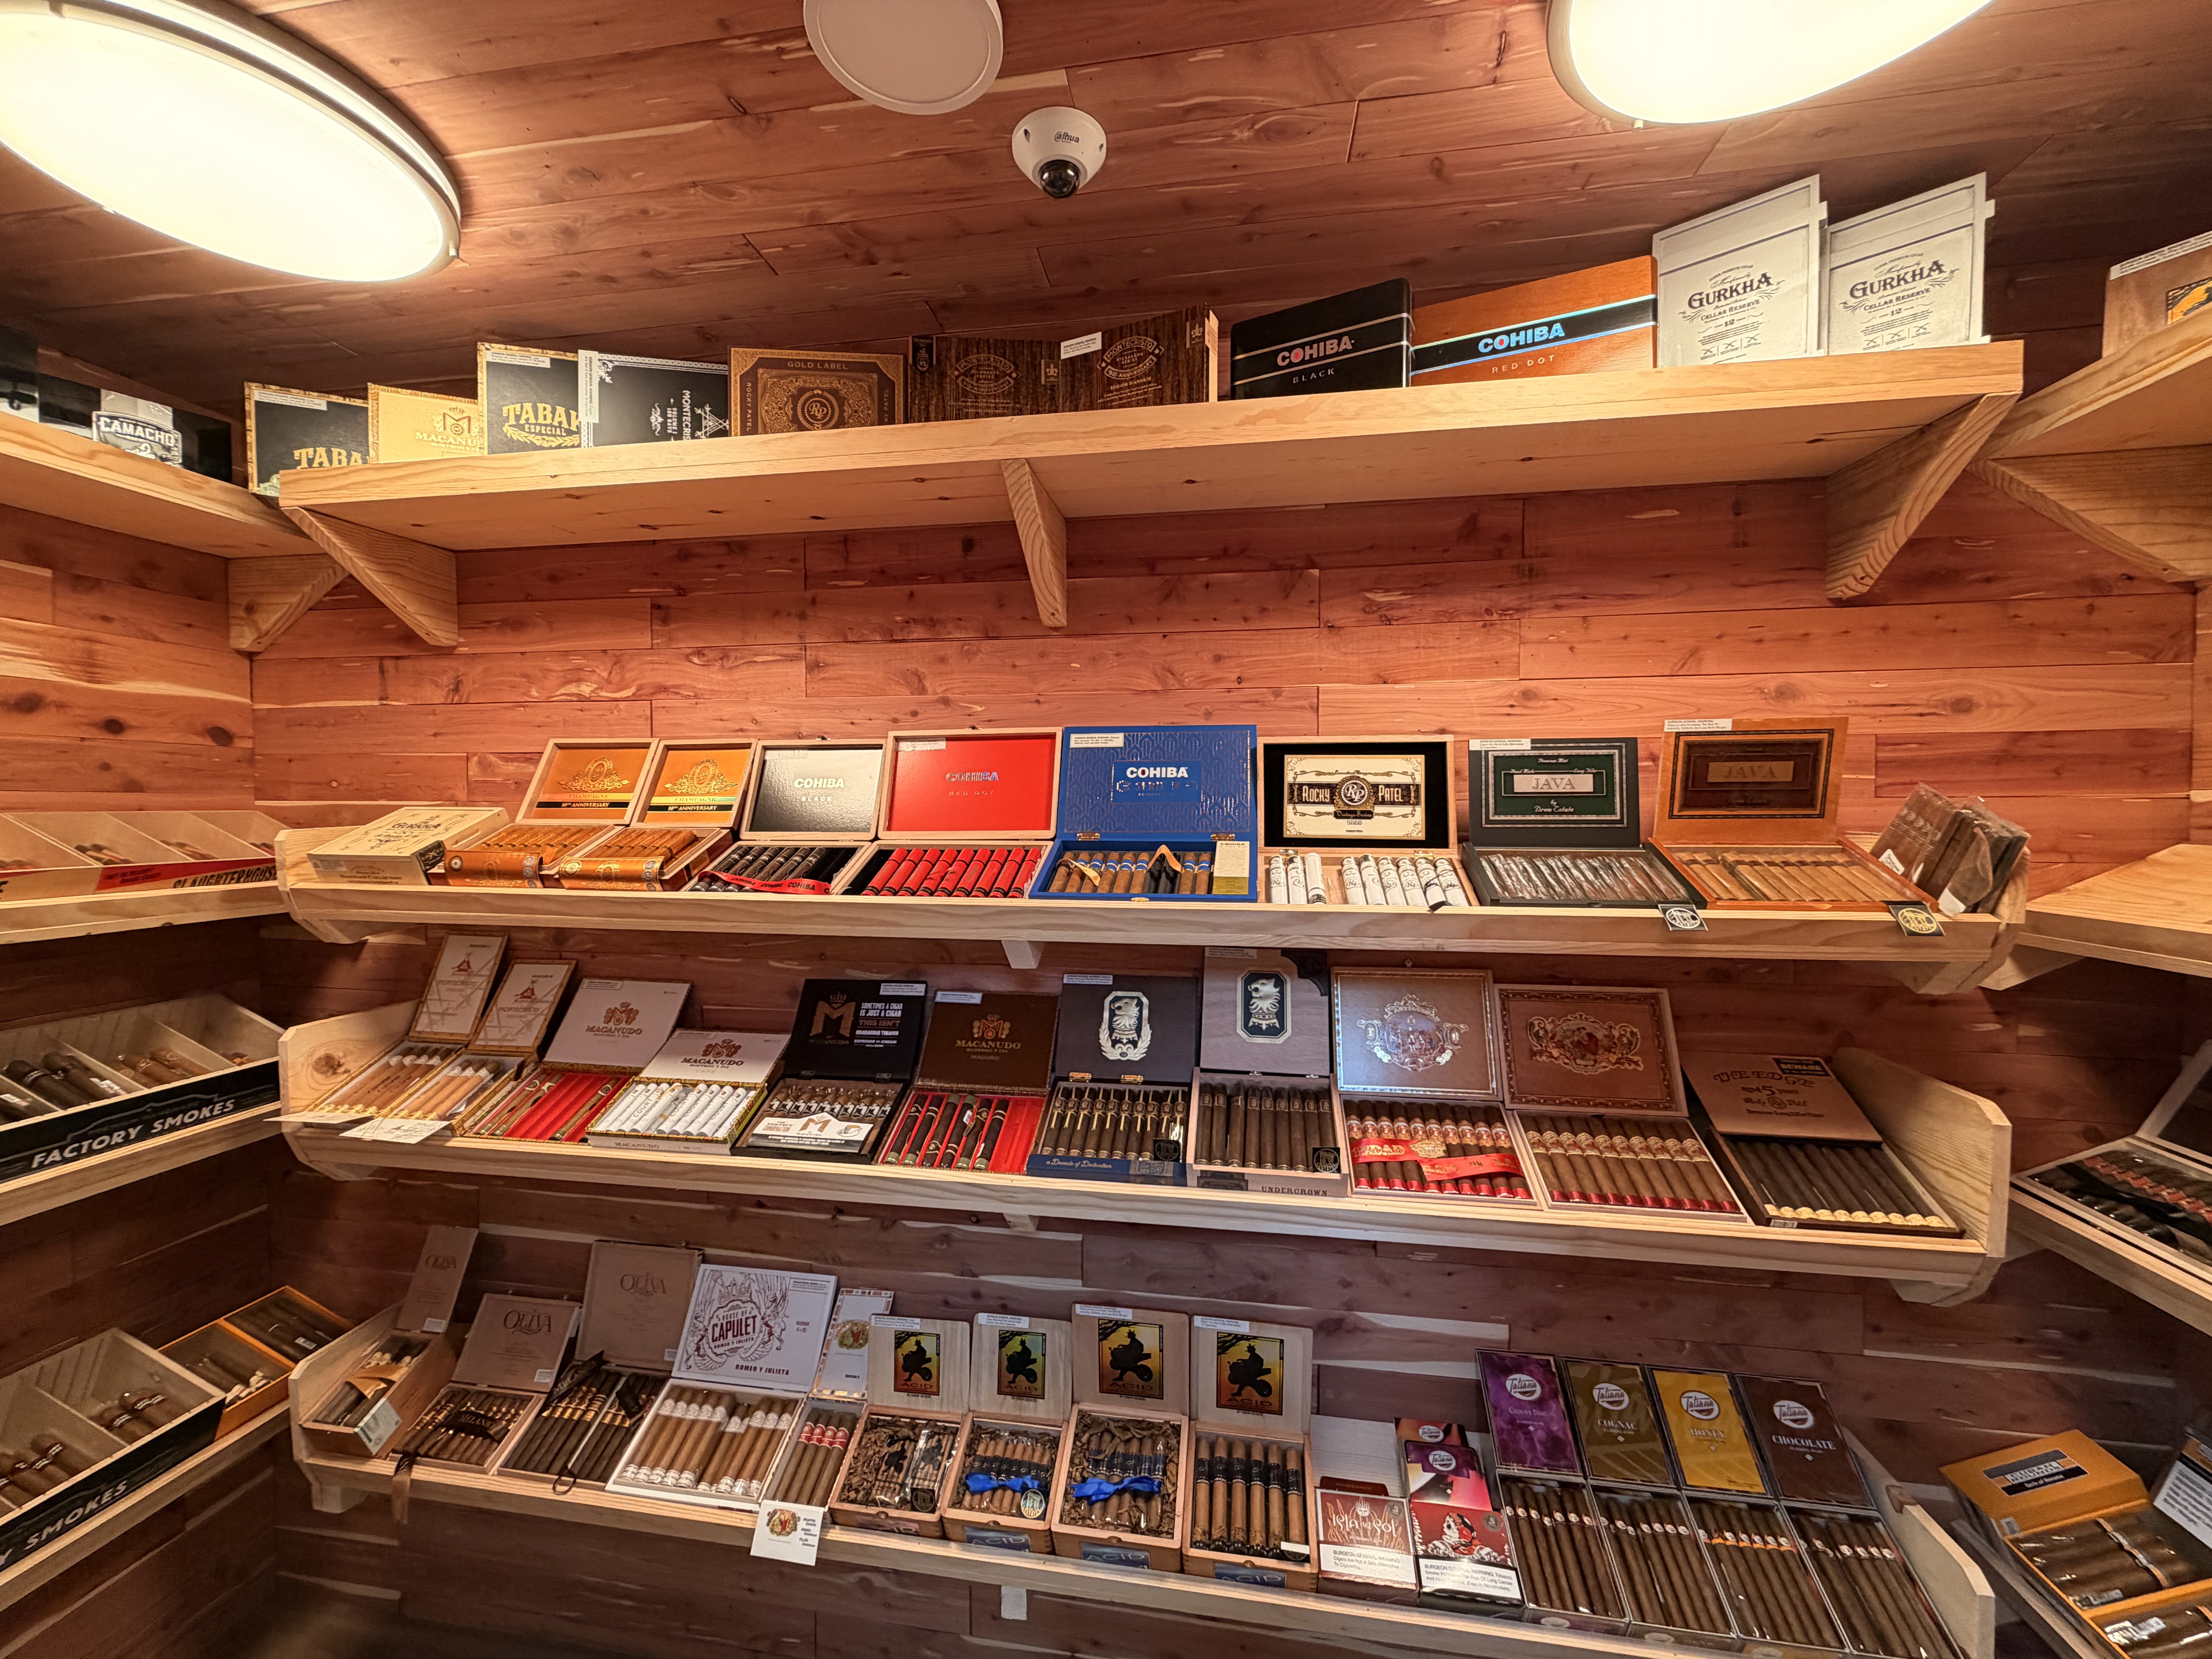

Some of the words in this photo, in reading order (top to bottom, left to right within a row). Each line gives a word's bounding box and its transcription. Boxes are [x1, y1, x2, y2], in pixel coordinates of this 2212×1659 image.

[1850, 259, 1947, 299] GURKHA
[1688, 272, 1774, 310] GURKHA
[1863, 300, 1893, 311] CELLAR
[1895, 287, 1930, 302] RESERVE
[1701, 310, 1727, 321] CELLAR
[1729, 299, 1760, 312] RESERVE
[1890, 308, 1902, 316] 12
[1724, 319, 1735, 327] 12
[1478, 323, 1565, 353] COHIBA
[1106, 339, 1153, 359] MONTECRISTO
[1277, 335, 1353, 366] COHIBA
[1492, 362, 1518, 374] RED
[1527, 355, 1555, 367] DOT
[1293, 368, 1335, 383] BLACK
[682, 390, 692, 440] MONTECRIS
[99, 416, 175, 447] CAMACHO
[525, 424, 567, 436] ESPECIAL
[415, 431, 479, 447] MACANU
[294, 447, 368, 470] TABA
[946, 771, 999, 782] COHIBA
[1126, 766, 1188, 779] COHIBA
[1723, 765, 1776, 778] JAVA
[794, 778, 845, 788] COHIBA
[1532, 778, 1576, 790] JAVA
[1302, 785, 1330, 802] ROCKY
[1378, 785, 1404, 802] PATEL
[787, 881, 816, 891] COHIBA
[585, 1025, 642, 1035] MACANUDO
[955, 1040, 1022, 1049] MACANUDO
[681, 1057, 744, 1066] MACANUDO
[1713, 1070, 1750, 1082] THE
[1752, 1071, 1815, 1088] EDGE
[1762, 1085, 1776, 1096] 5
[633, 1097, 653, 1118] COURT
[31, 1125, 143, 1168] FACTORY
[151, 1099, 235, 1133] SMOKES
[1051, 1158, 1073, 1167] Decade
[1081, 1160, 1112, 1169] Dedication
[1261, 1186, 1328, 1196] UNDERCROWN
[722, 1312, 738, 1321] HOUSE
[712, 1315, 757, 1343] CAPULET
[735, 1364, 757, 1372] ROMEO
[765, 1367, 790, 1376] JULIETA
[1004, 1383, 1038, 1391] ACID
[1109, 1381, 1154, 1391] ACID
[1506, 1377, 1537, 1394] Tatiana
[1593, 1387, 1625, 1402] Tatiana
[1226, 1398, 1273, 1407] ACID
[1681, 1396, 1714, 1412] Tatiana
[1774, 1405, 1808, 1420] Tatiana
[1597, 1419, 1638, 1430] COGNAC
[1691, 1427, 1726, 1439] HONEY
[1772, 1435, 1836, 1450] CHOCOLATE
[1430, 1453, 1453, 1464] Tatiana
[24, 1480, 128, 1549] SMOKES
